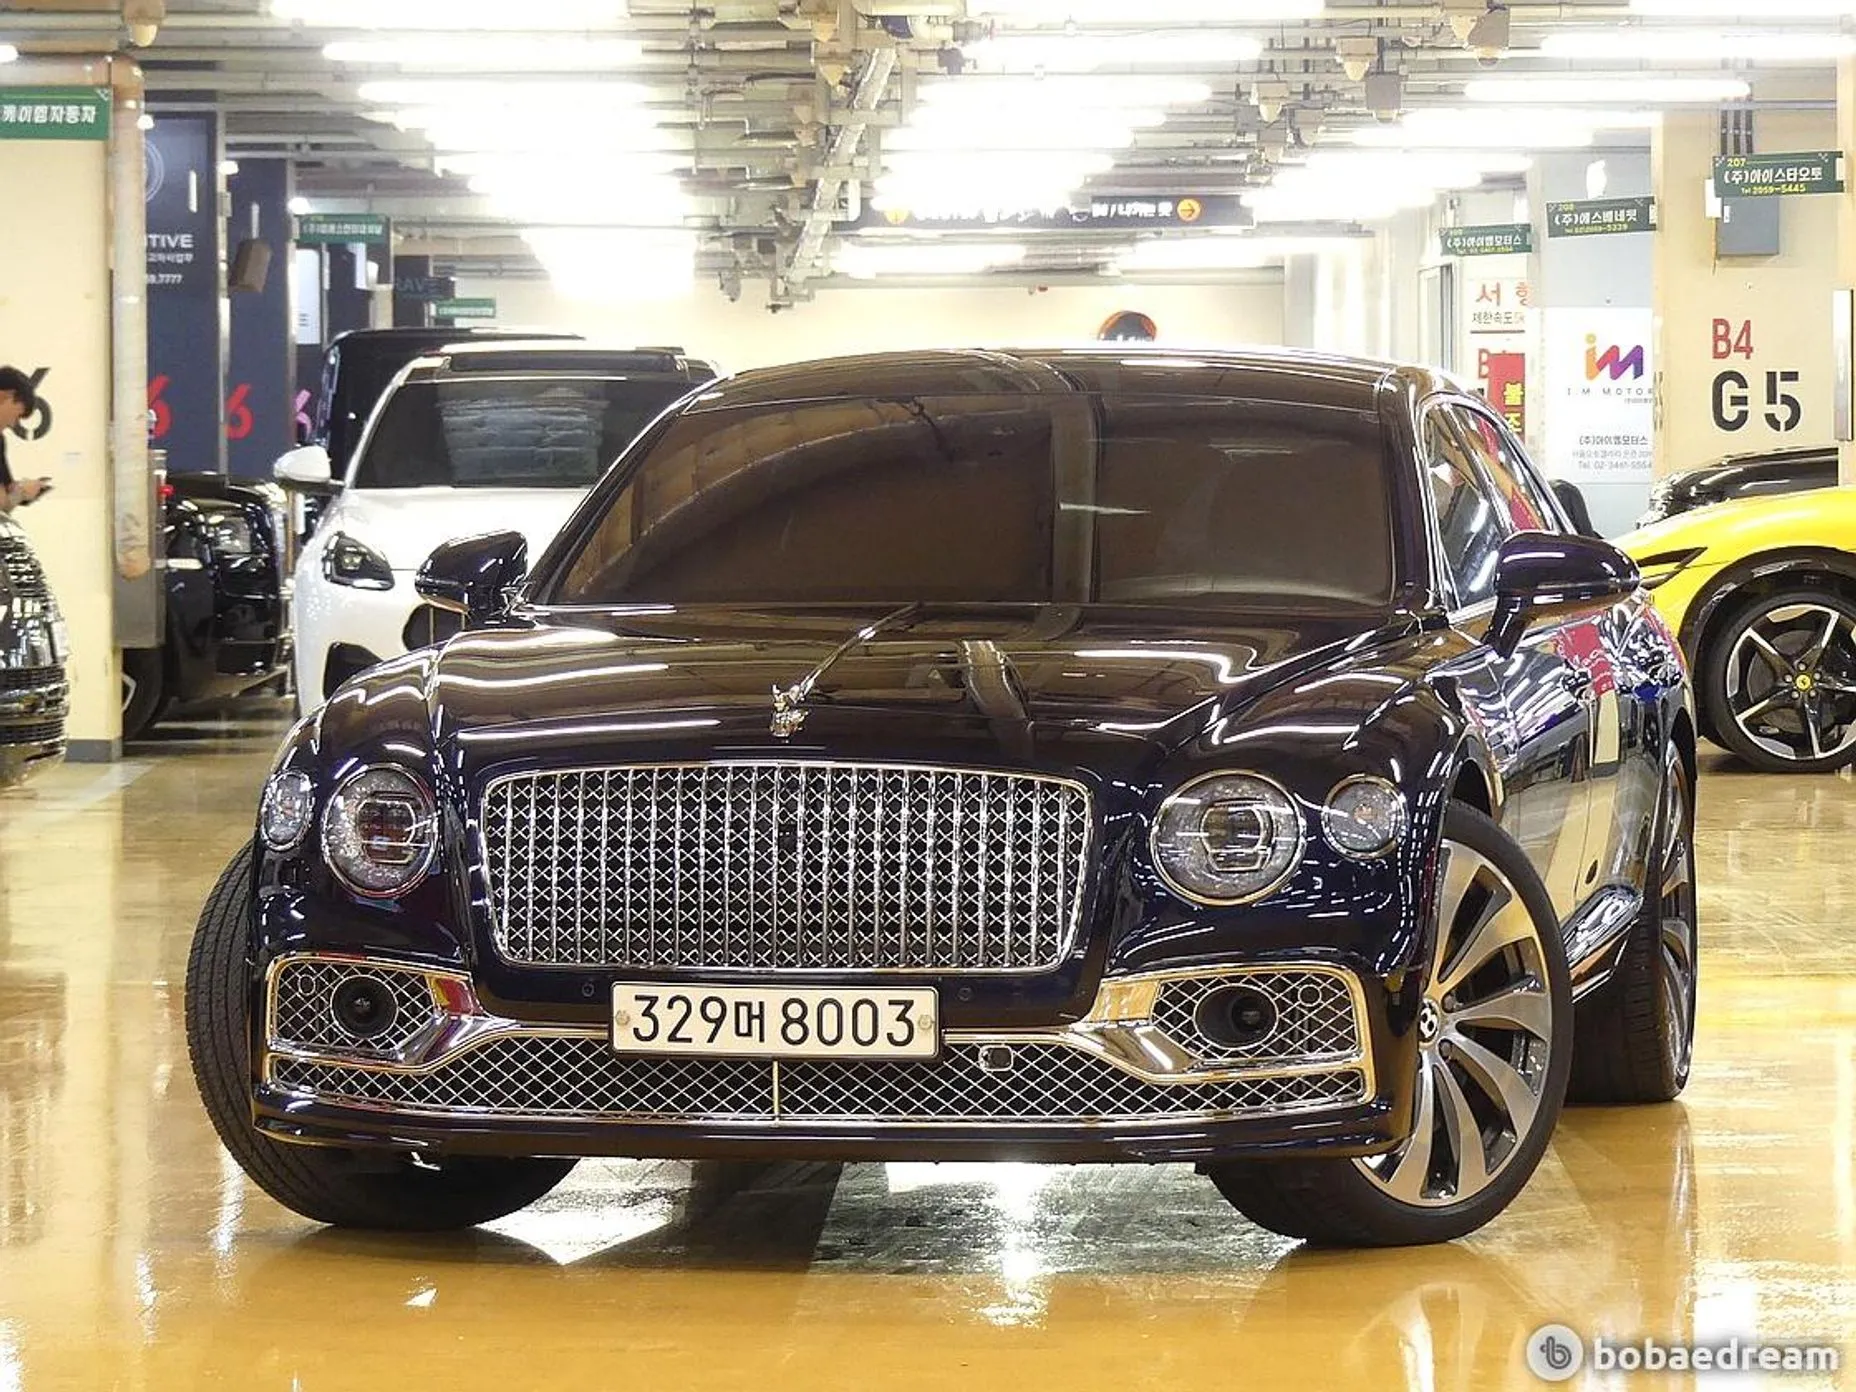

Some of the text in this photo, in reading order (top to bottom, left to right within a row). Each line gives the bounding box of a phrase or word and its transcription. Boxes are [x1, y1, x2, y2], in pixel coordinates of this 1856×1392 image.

[1727, 158, 1746, 167] 207
[1724, 166, 1823, 184] (주)아이스타오토
[1712, 318, 1754, 360] B4
